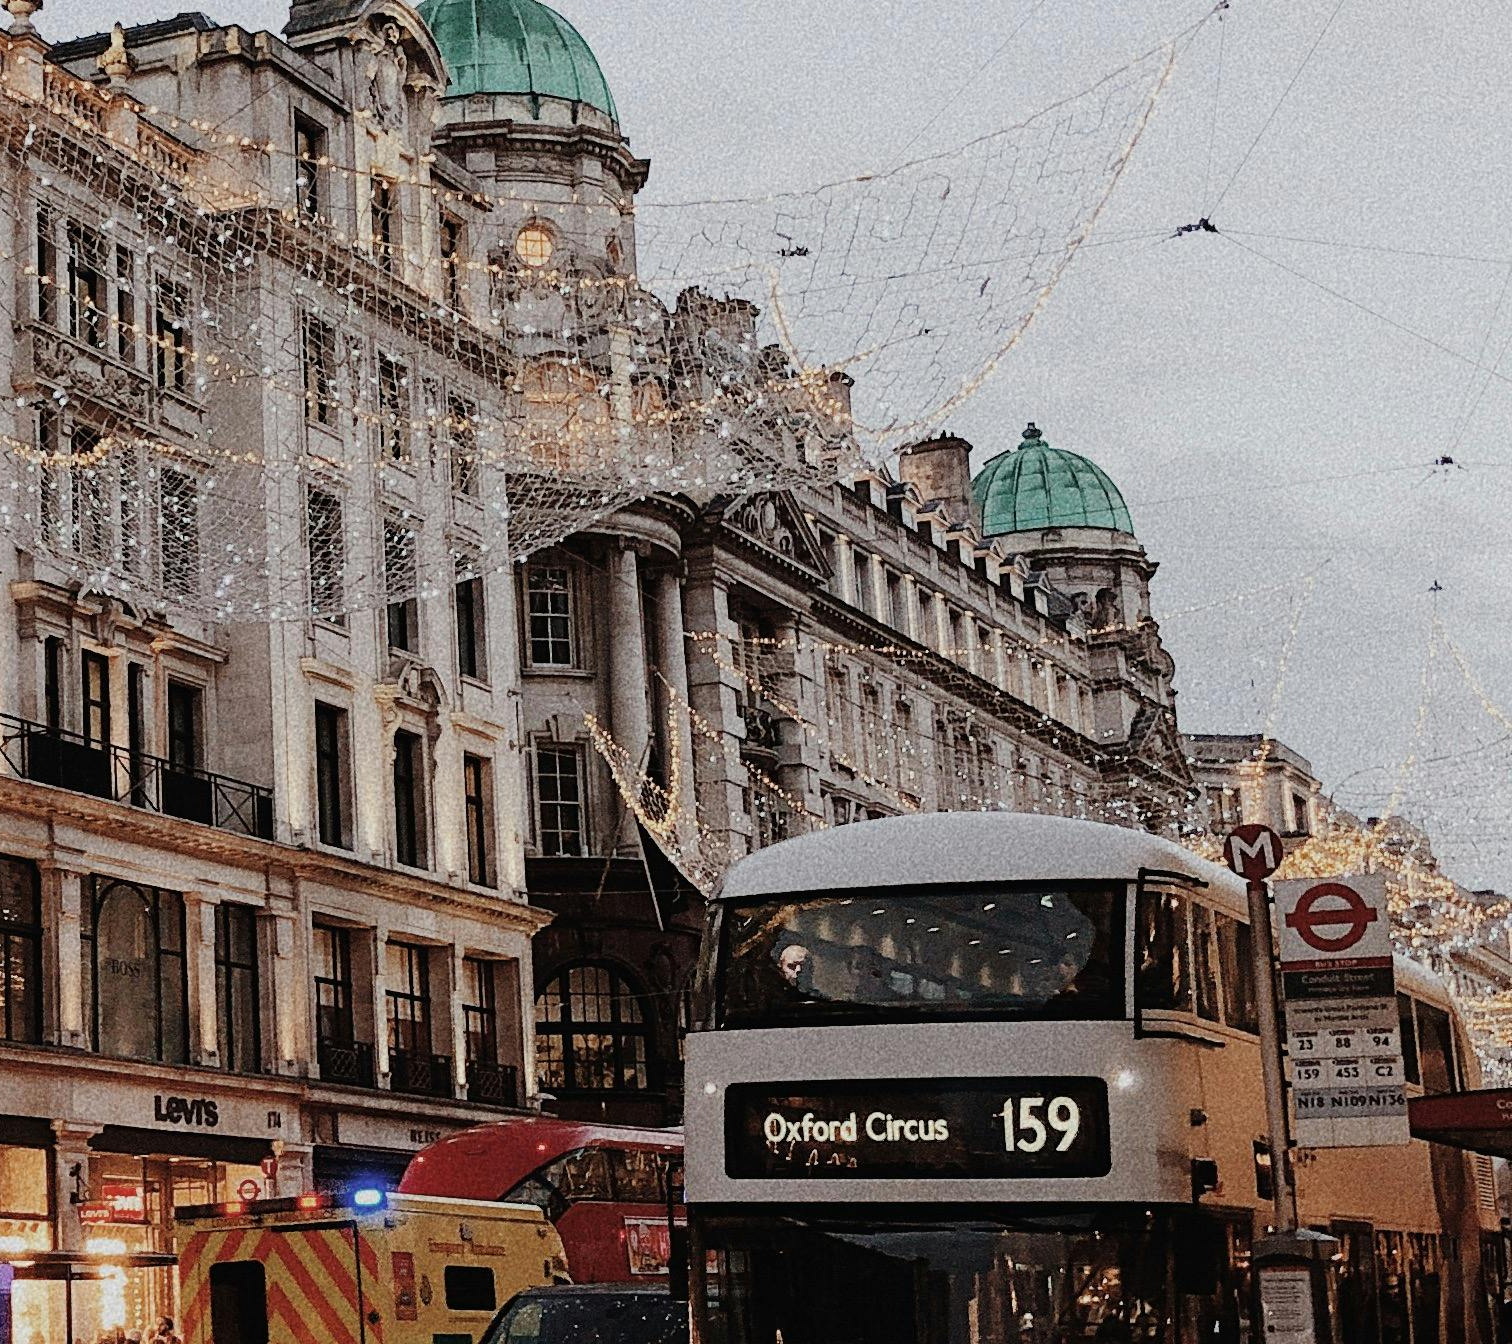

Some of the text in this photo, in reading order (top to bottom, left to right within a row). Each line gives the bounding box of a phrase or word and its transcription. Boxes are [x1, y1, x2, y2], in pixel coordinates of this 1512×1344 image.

[1230, 831, 1276, 873] M
[1298, 1036, 1390, 1050] 23 88 94
[1297, 1065, 1394, 1080] 159 453 C2
[1297, 1094, 1406, 1108] N18 N109 N136
[764, 1096, 1081, 1152] Oxford Circus 159
[263, 1159, 274, 1174] T
